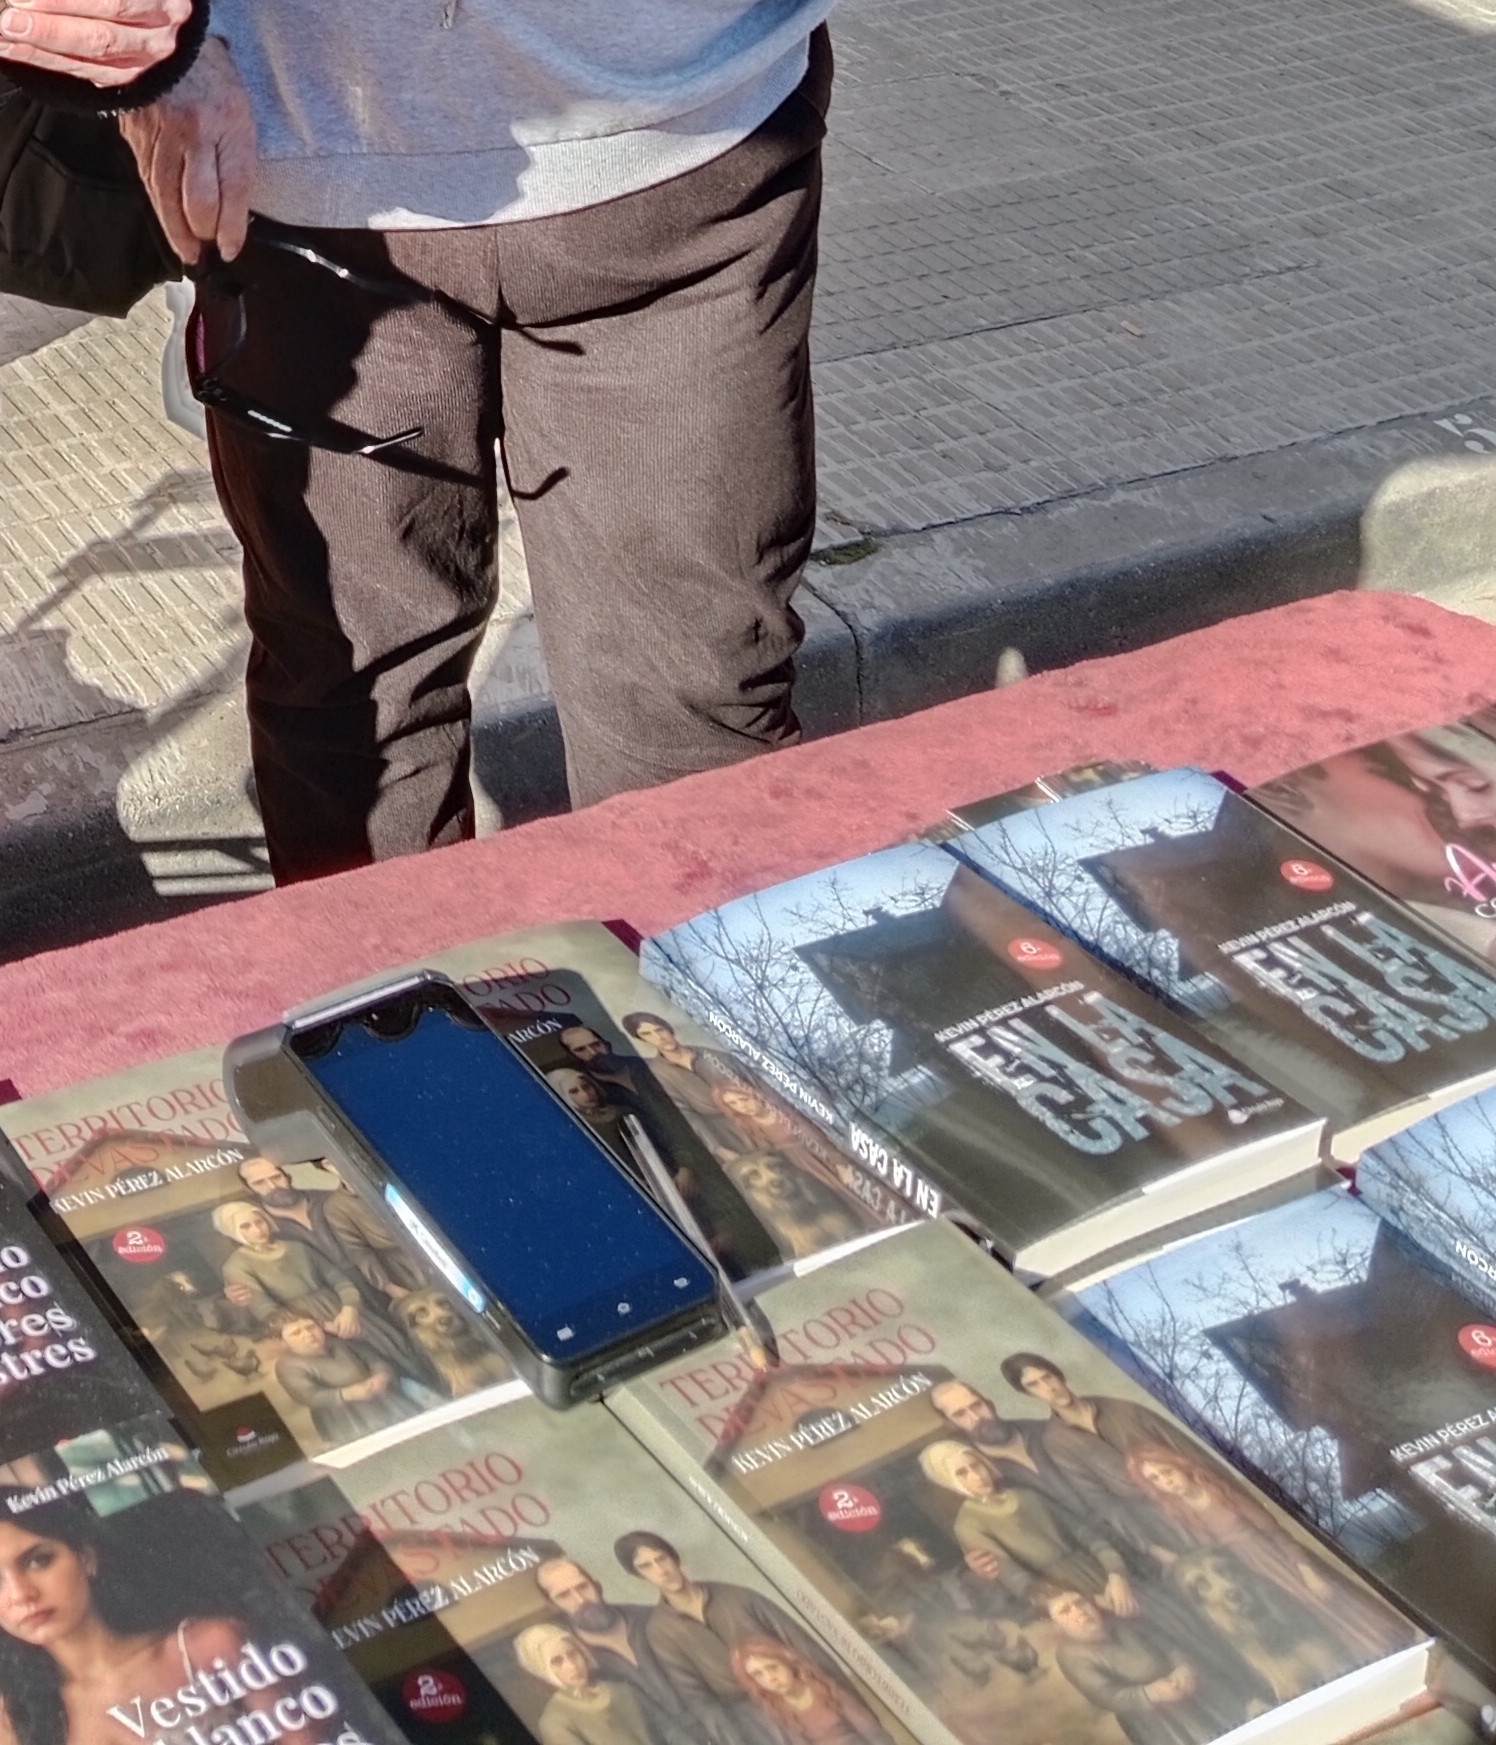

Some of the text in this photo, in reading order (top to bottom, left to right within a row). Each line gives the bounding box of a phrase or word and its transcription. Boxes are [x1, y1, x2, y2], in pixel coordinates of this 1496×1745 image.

[1217, 900, 1357, 955] KEVIN PÉREZ ALARCÓN
[1232, 911, 1430, 1000] EN LA
[934, 980, 1085, 1043] KEVIN PÉREZ ALARCÓN
[1302, 952, 1496, 1063] CASA
[947, 992, 1155, 1090] EN LA
[800, 1089, 834, 1125] KEVIN
[1016, 1032, 1269, 1155] CASA
[106, 1170, 163, 1199] PÉREZ
[165, 1148, 245, 1183] ALARCÓN
[850, 1121, 888, 1177] CASA
[893, 1157, 913, 1197] LA
[916, 1178, 941, 1219] EN
[731, 1371, 933, 1474] KEVIN PÉREZ ALARCÓN
[1390, 1433, 1438, 1462] KEVIN
[1437, 1413, 1490, 1445] PÉREZ
[5, 1445, 171, 1514] Kevin Pérez Alarcón
[330, 1545, 541, 1651] EVIN PÉREZ ALARCÓN
[106, 1639, 308, 1739] Vestido
